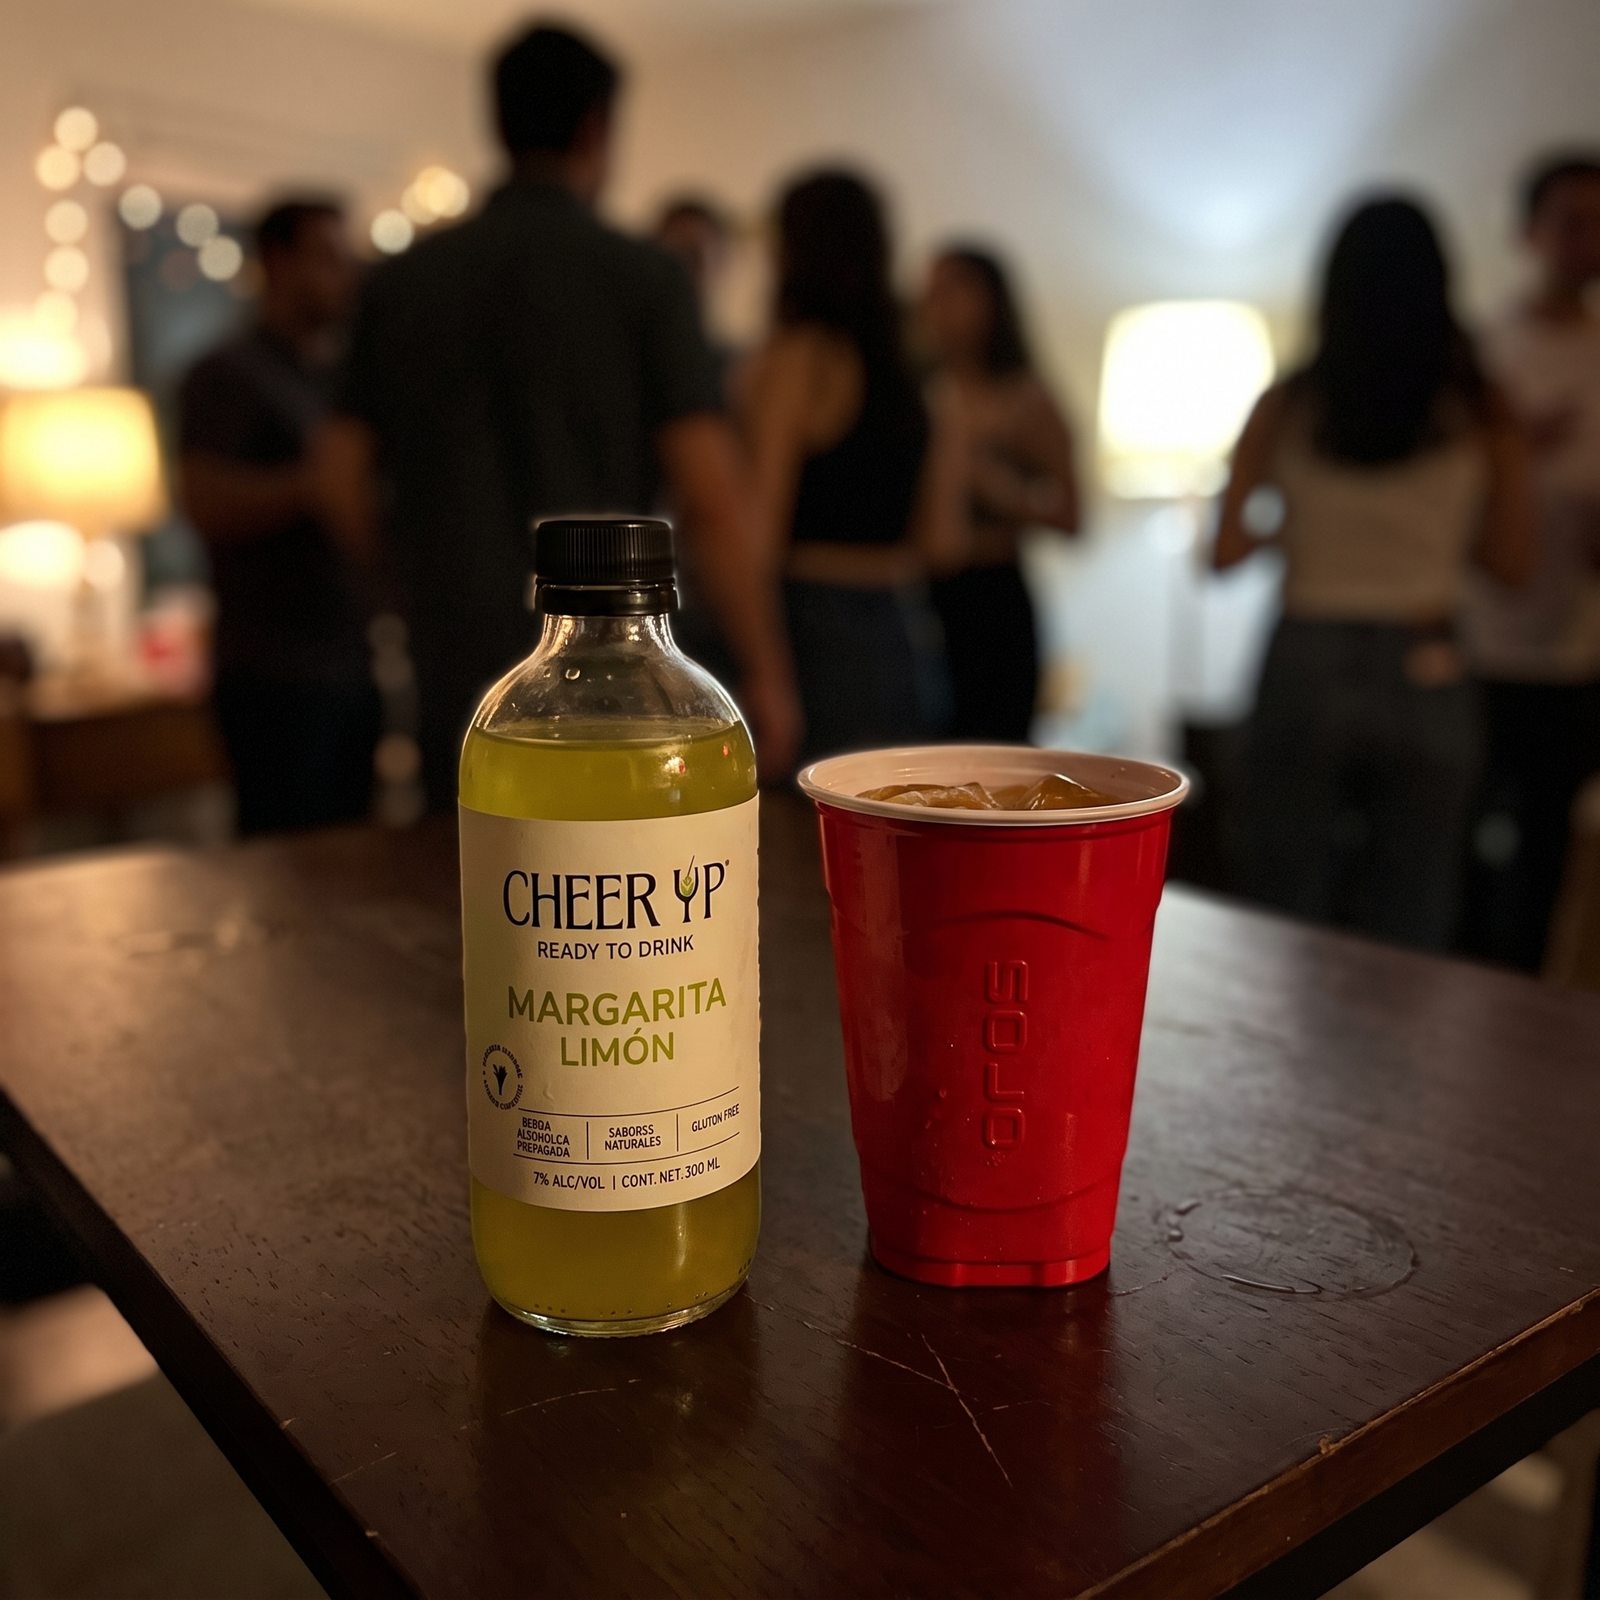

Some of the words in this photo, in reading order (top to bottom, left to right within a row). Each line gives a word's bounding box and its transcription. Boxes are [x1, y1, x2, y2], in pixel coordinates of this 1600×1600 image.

[503, 869, 661, 929] CHEER
[537, 940, 600, 960] READY
[606, 943, 632, 959] TO
[639, 934, 694, 958] DRINK
[508, 977, 727, 1026] MARGARITA
[560, 1027, 674, 1067] LIMÓN
[609, 1124, 654, 1138] SABORSS
[691, 1114, 723, 1132] GLUTON
[723, 1103, 740, 1119] FREE
[517, 1141, 570, 1158] PREPAGADA
[604, 1136, 661, 1151] NATURALES
[533, 1171, 549, 1186] 7%
[552, 1174, 605, 1190] ALC/VOL
[621, 1172, 657, 1188] CONT.
[659, 1168, 684, 1184] NET.
[685, 1162, 705, 1179] 300
[707, 1157, 721, 1171] ML
